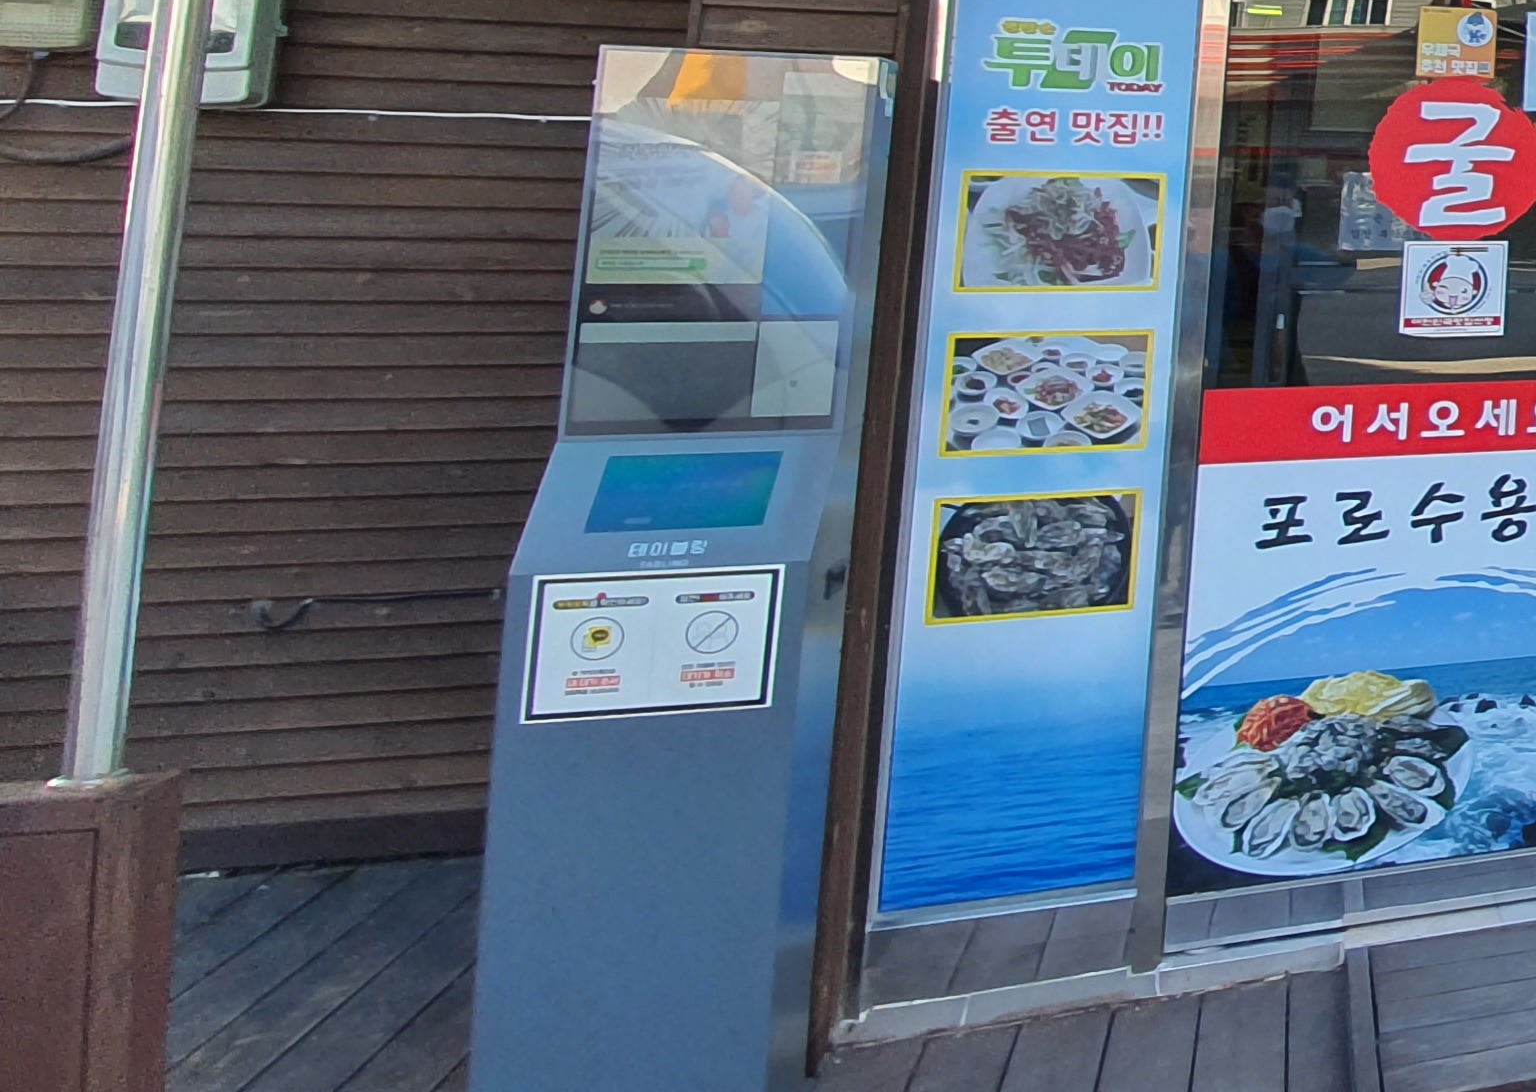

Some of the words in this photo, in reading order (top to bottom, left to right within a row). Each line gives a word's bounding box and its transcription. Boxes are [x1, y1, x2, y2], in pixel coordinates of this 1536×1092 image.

[984, 30, 1160, 89] 투데이
[1107, 82, 1163, 92] TODAY
[986, 109, 1056, 142] 출연
[1072, 112, 1162, 144] 맛집!!
[1403, 102, 1515, 226] 굴
